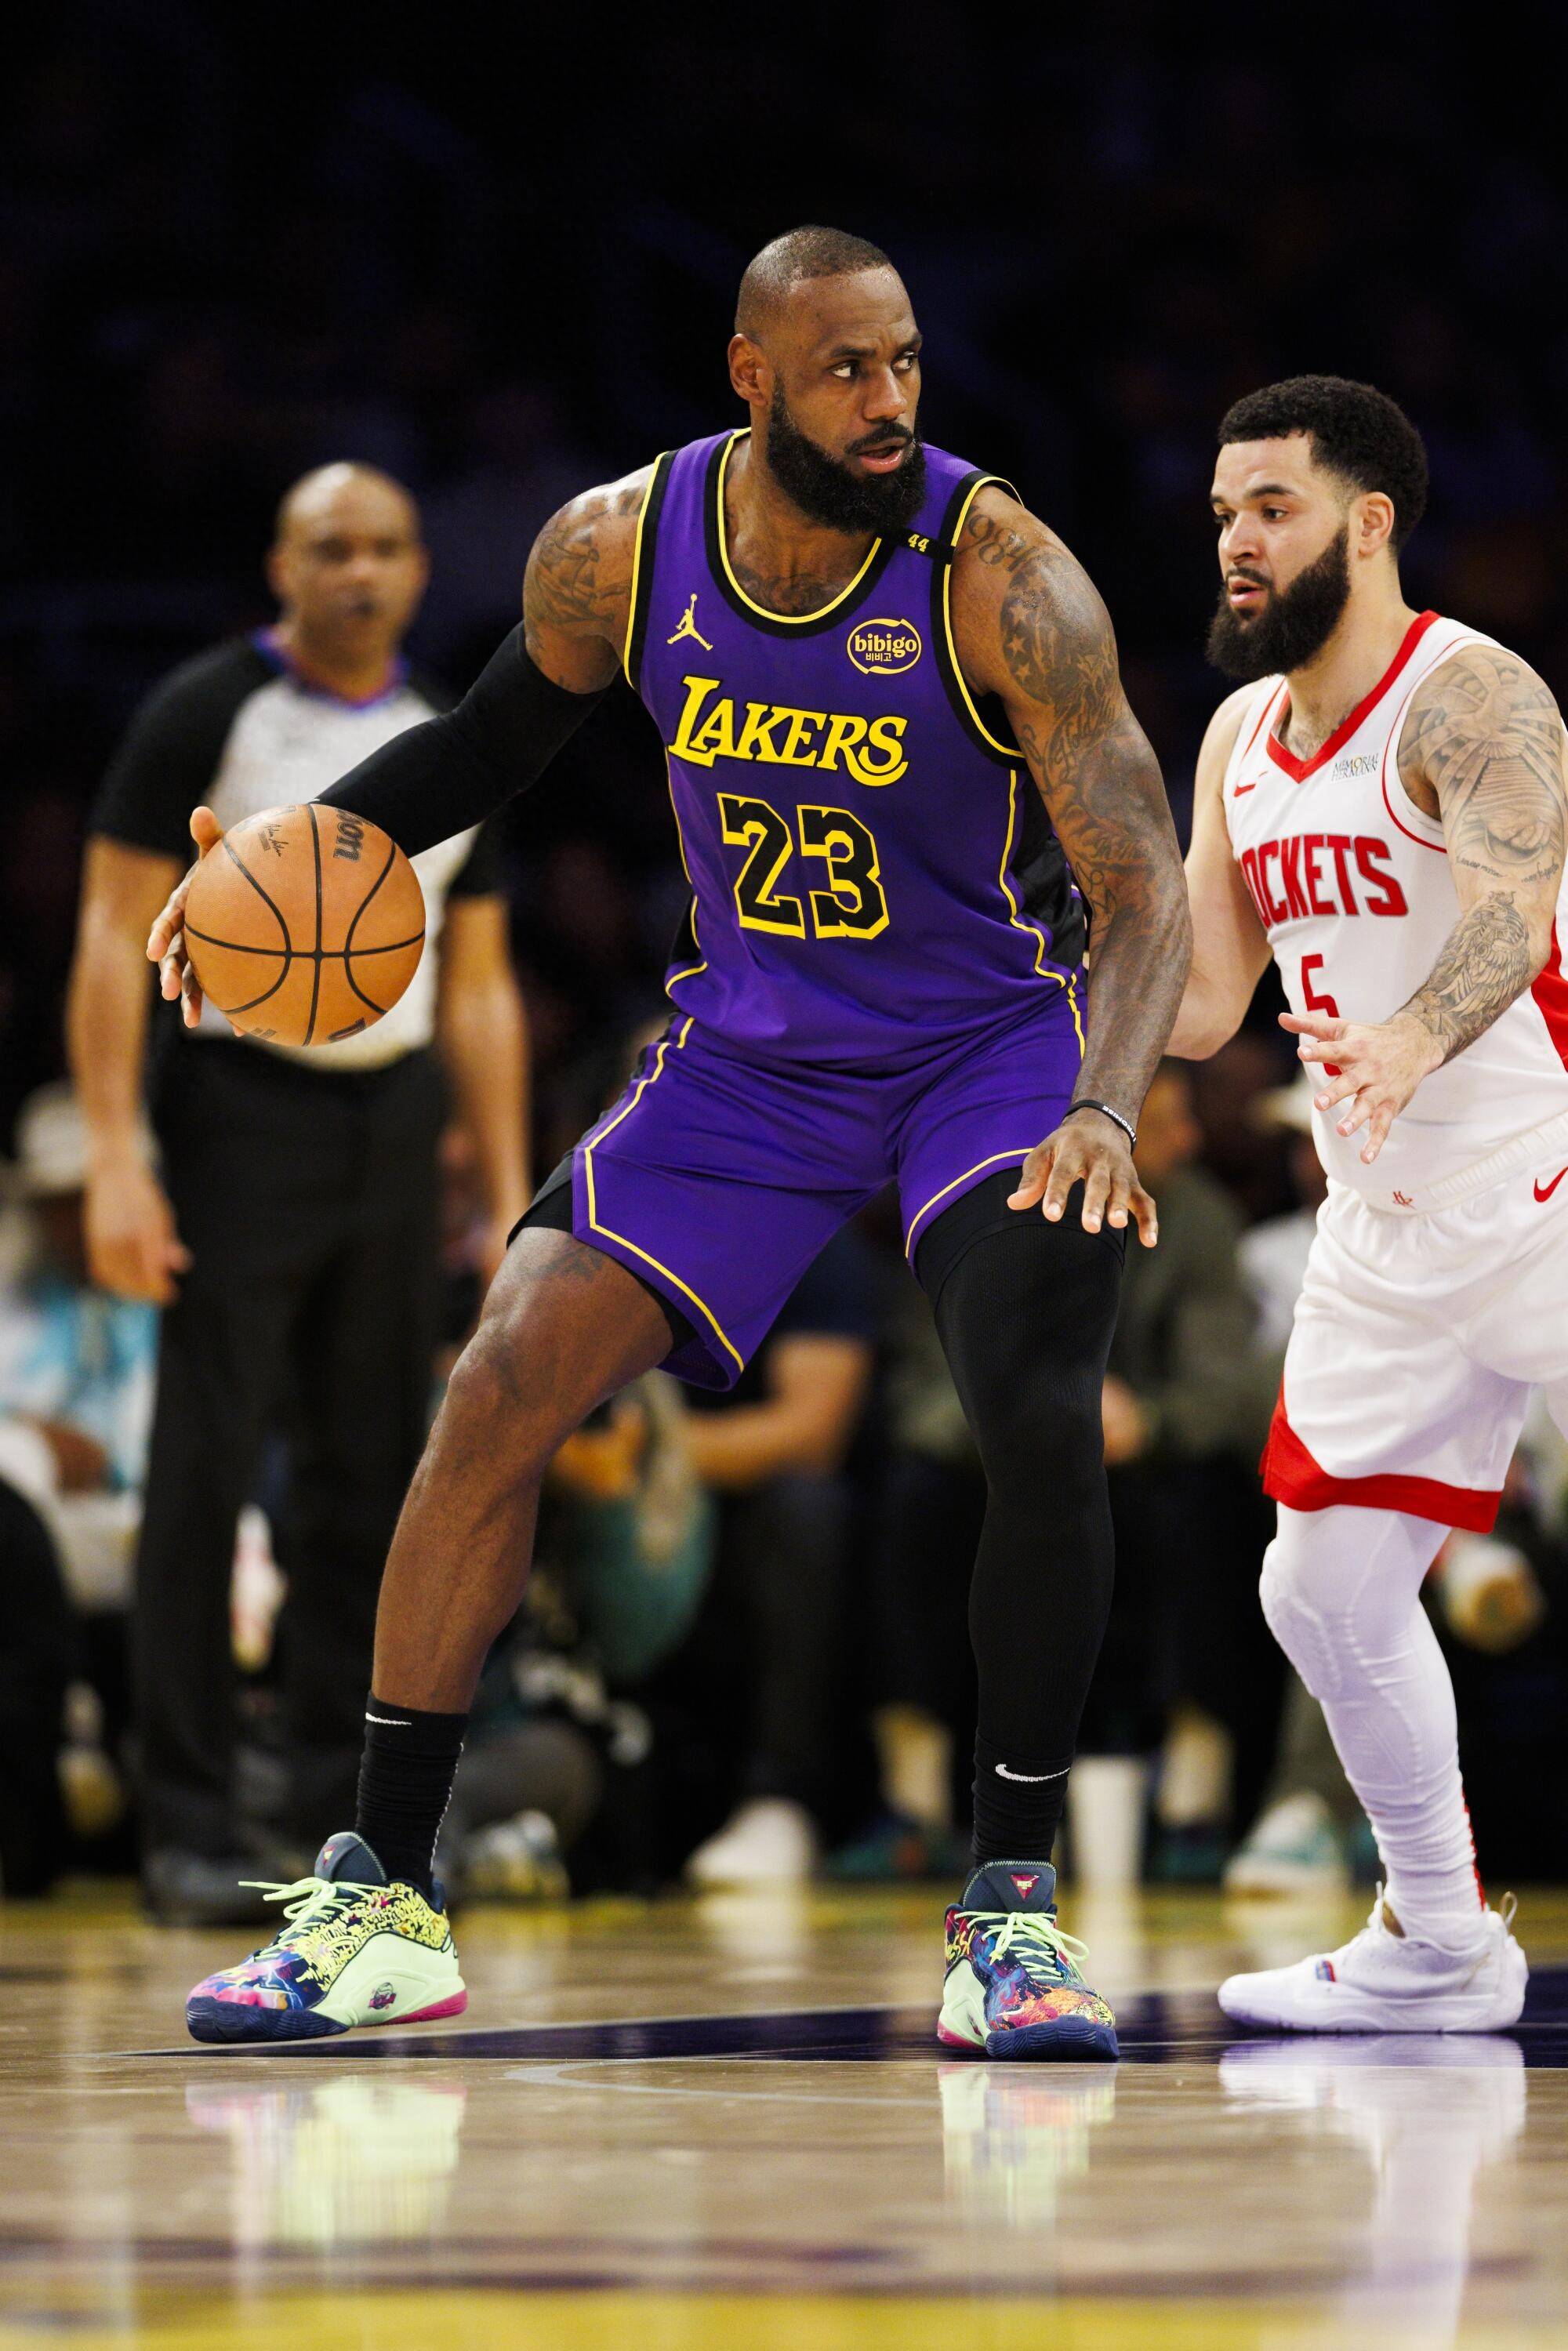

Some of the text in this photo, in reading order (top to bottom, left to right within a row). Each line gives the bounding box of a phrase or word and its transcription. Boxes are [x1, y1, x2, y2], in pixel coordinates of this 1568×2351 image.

[908, 534, 930, 553] 44
[855, 633, 917, 658] bibigo
[866, 652, 892, 662] 비비고
[669, 675, 909, 786] LAKERS
[1330, 764, 1376, 782] HERMANN
[1334, 753, 1379, 773] MEMORIAL
[717, 793, 890, 940] 23
[1240, 833, 1410, 930] OCKETS
[1301, 953, 1343, 1077] 5
